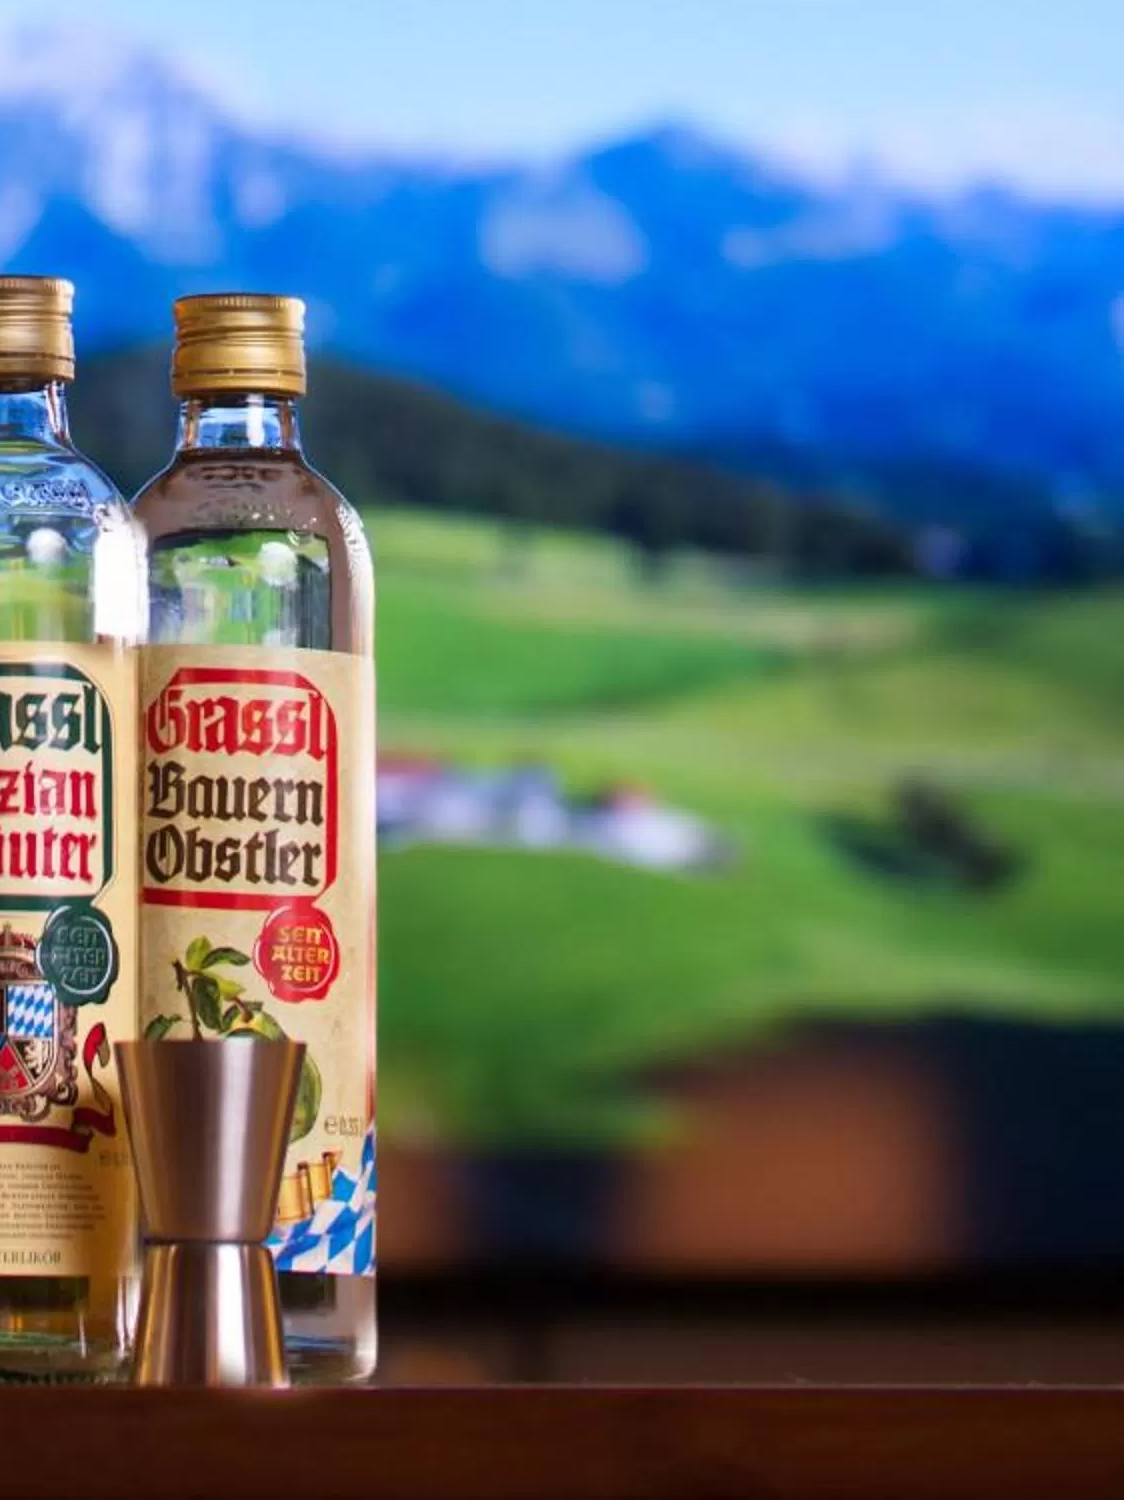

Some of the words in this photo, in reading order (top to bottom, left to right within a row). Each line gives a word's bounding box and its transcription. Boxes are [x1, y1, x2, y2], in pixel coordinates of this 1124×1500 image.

[147, 688, 326, 760] Grassl
[147, 759, 324, 826] Bauern
[146, 823, 322, 887] Obstler
[271, 946, 330, 965] ALTER
[279, 925, 323, 945] SEIT
[281, 965, 323, 982] ZEIT
